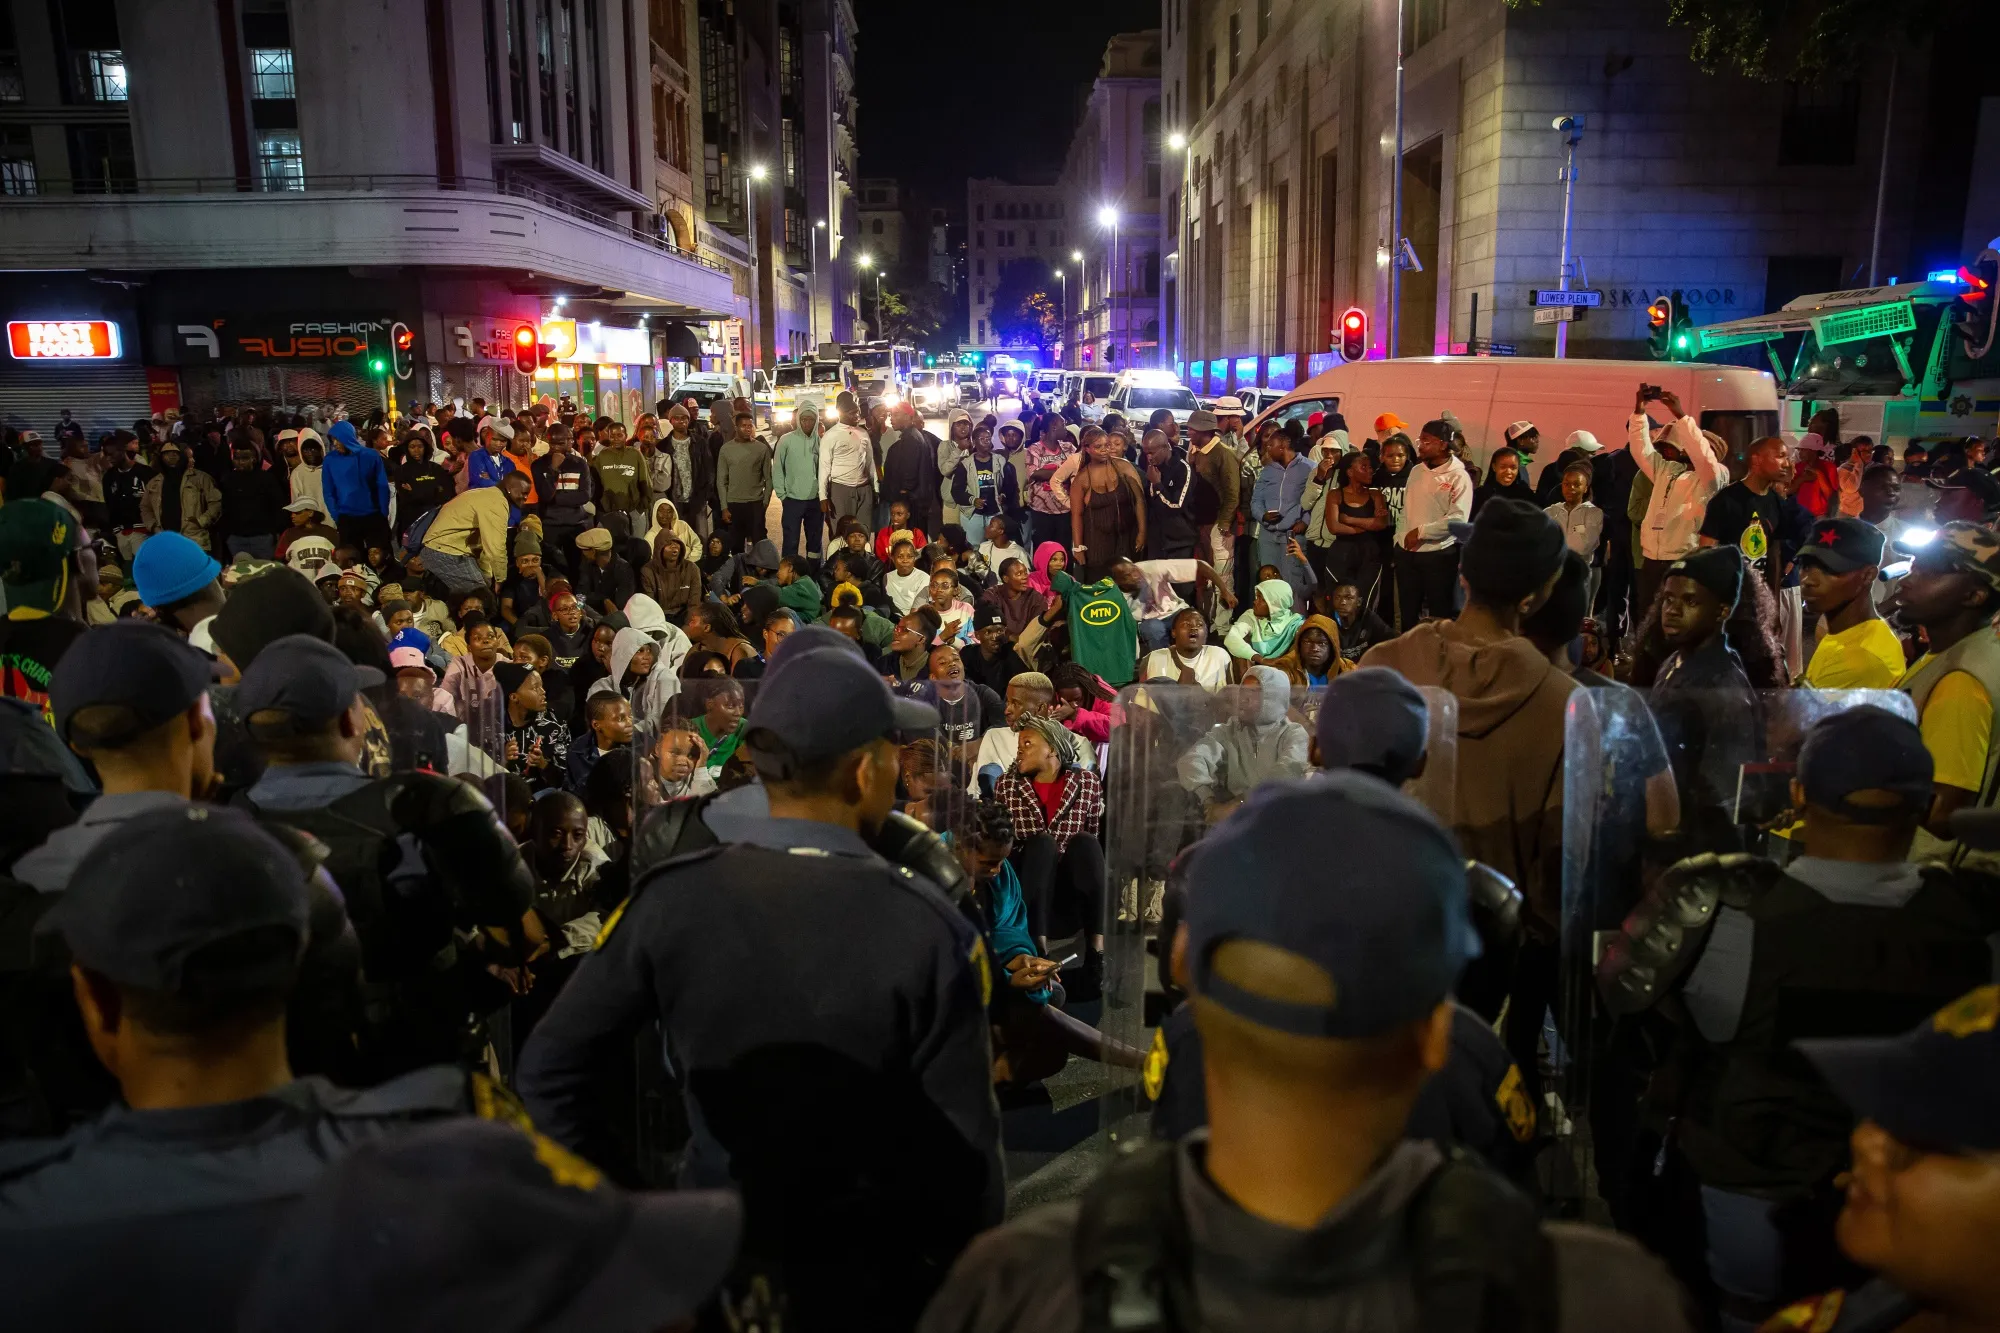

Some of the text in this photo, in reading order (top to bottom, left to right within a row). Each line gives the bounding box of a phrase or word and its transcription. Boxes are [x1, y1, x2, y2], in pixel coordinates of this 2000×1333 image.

[1541, 293, 1565, 303] LOWER
[1568, 294, 1588, 304] PLEIN
[27, 323, 92, 342] FAST
[1090, 607, 1112, 618] MTN
